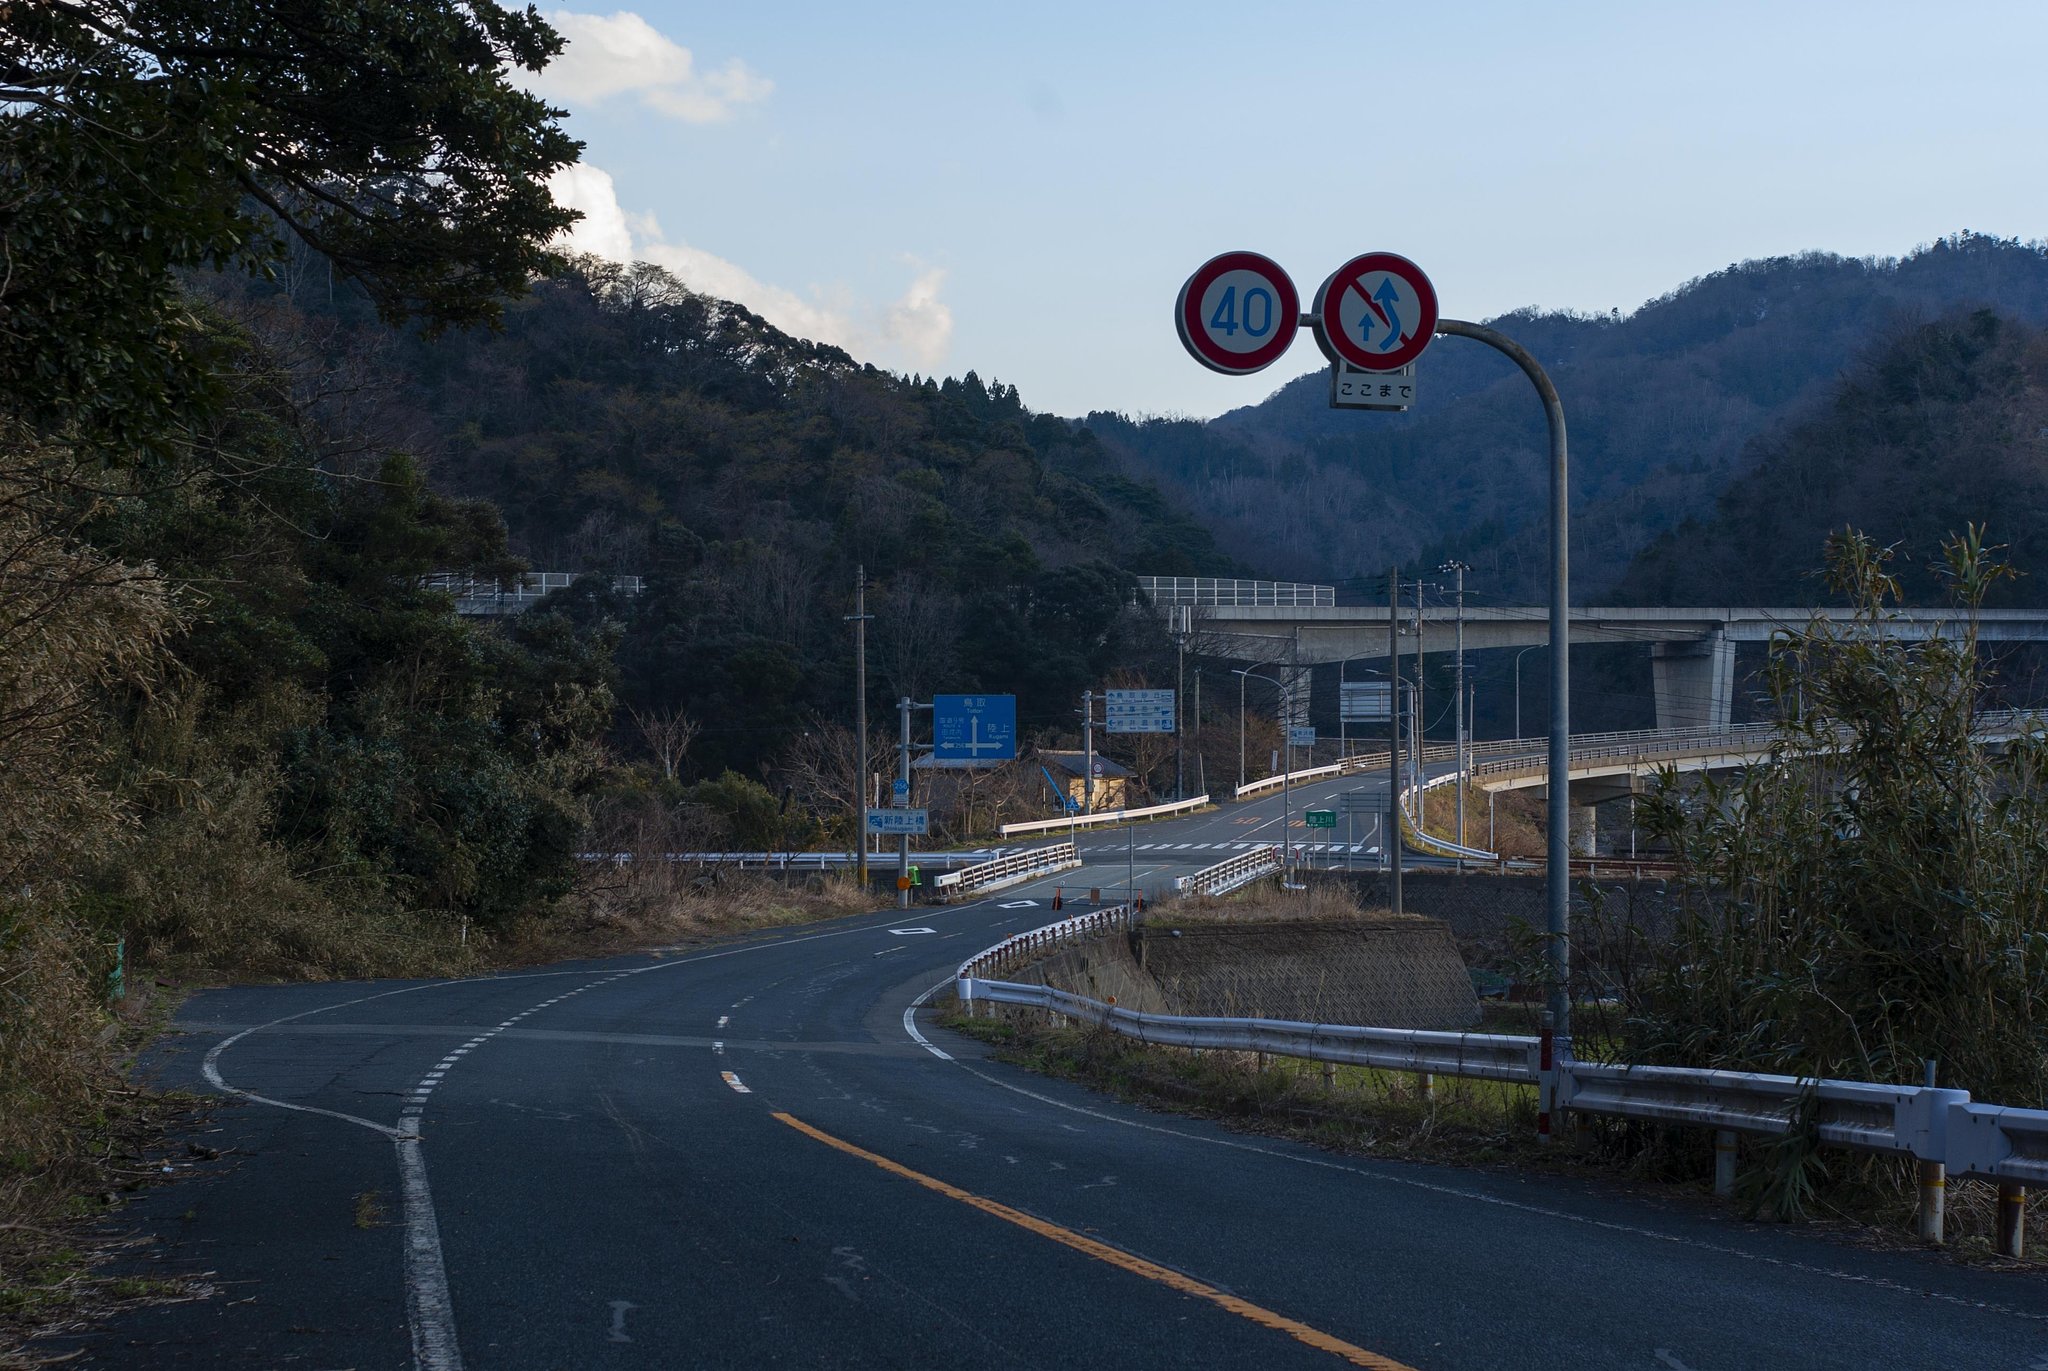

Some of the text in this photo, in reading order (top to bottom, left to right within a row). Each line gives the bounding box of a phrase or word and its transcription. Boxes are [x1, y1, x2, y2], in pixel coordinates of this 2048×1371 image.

[1211, 286, 1272, 336] 40
[1340, 383, 1412, 397] ここまで
[964, 697, 986, 707] 鳥取
[988, 723, 1010, 733] 陸上
[884, 816, 924, 825] 新陸上橋
[1309, 815, 1333, 823] 陸上川
